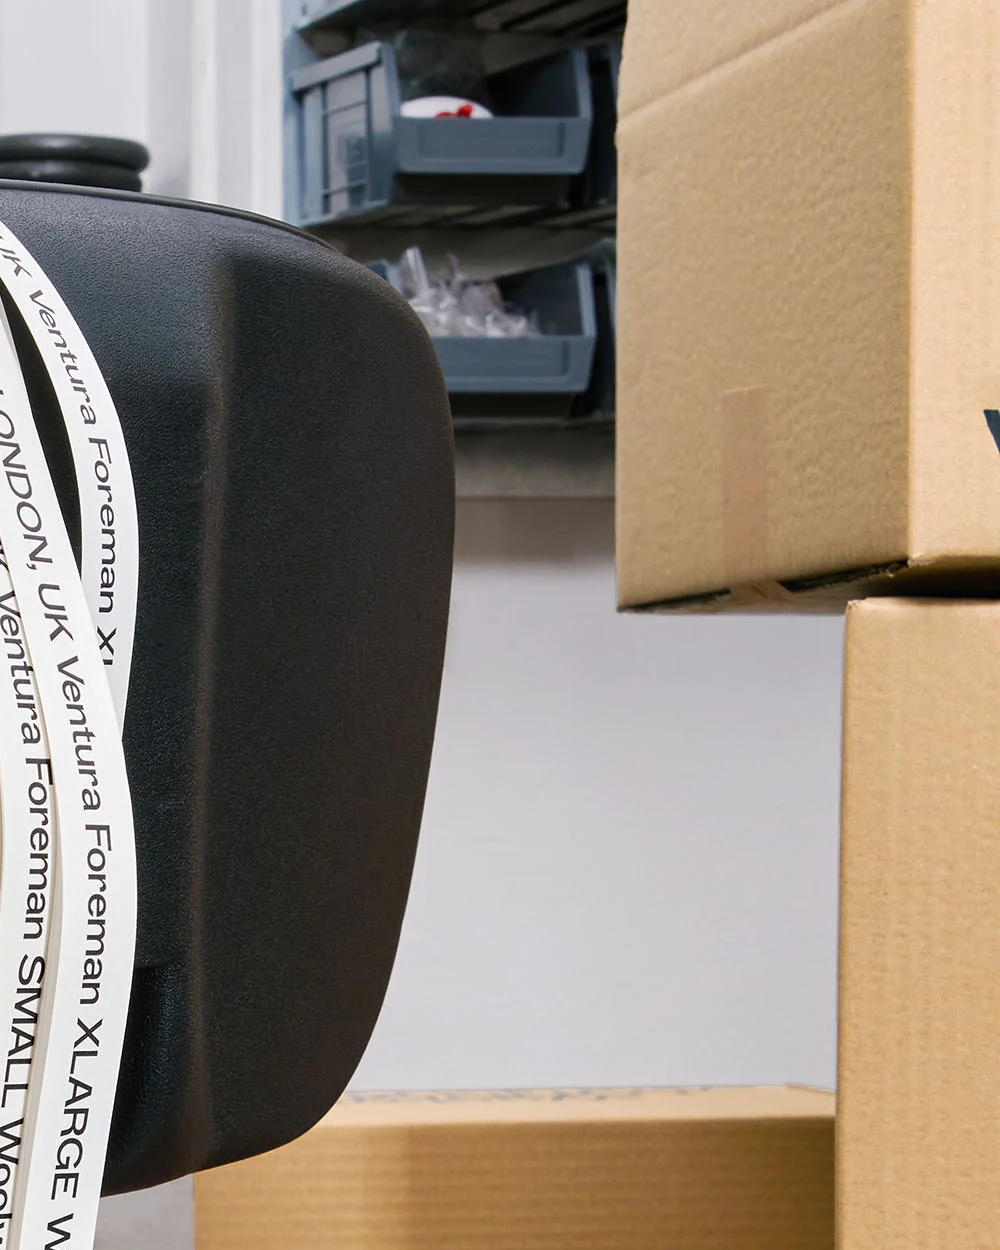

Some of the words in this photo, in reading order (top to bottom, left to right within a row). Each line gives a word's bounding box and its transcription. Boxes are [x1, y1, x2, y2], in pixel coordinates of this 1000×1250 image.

[29, 289, 97, 425] Ventura
[88, 437, 116, 614] Foreman
[38, 584, 74, 642] UK
[57, 655, 102, 811] Ventura
[23, 757, 54, 940] Foreman
[80, 824, 112, 1005] Foreman
[1, 954, 45, 1108] SMALL
[51, 1018, 103, 1201] XLARGE
